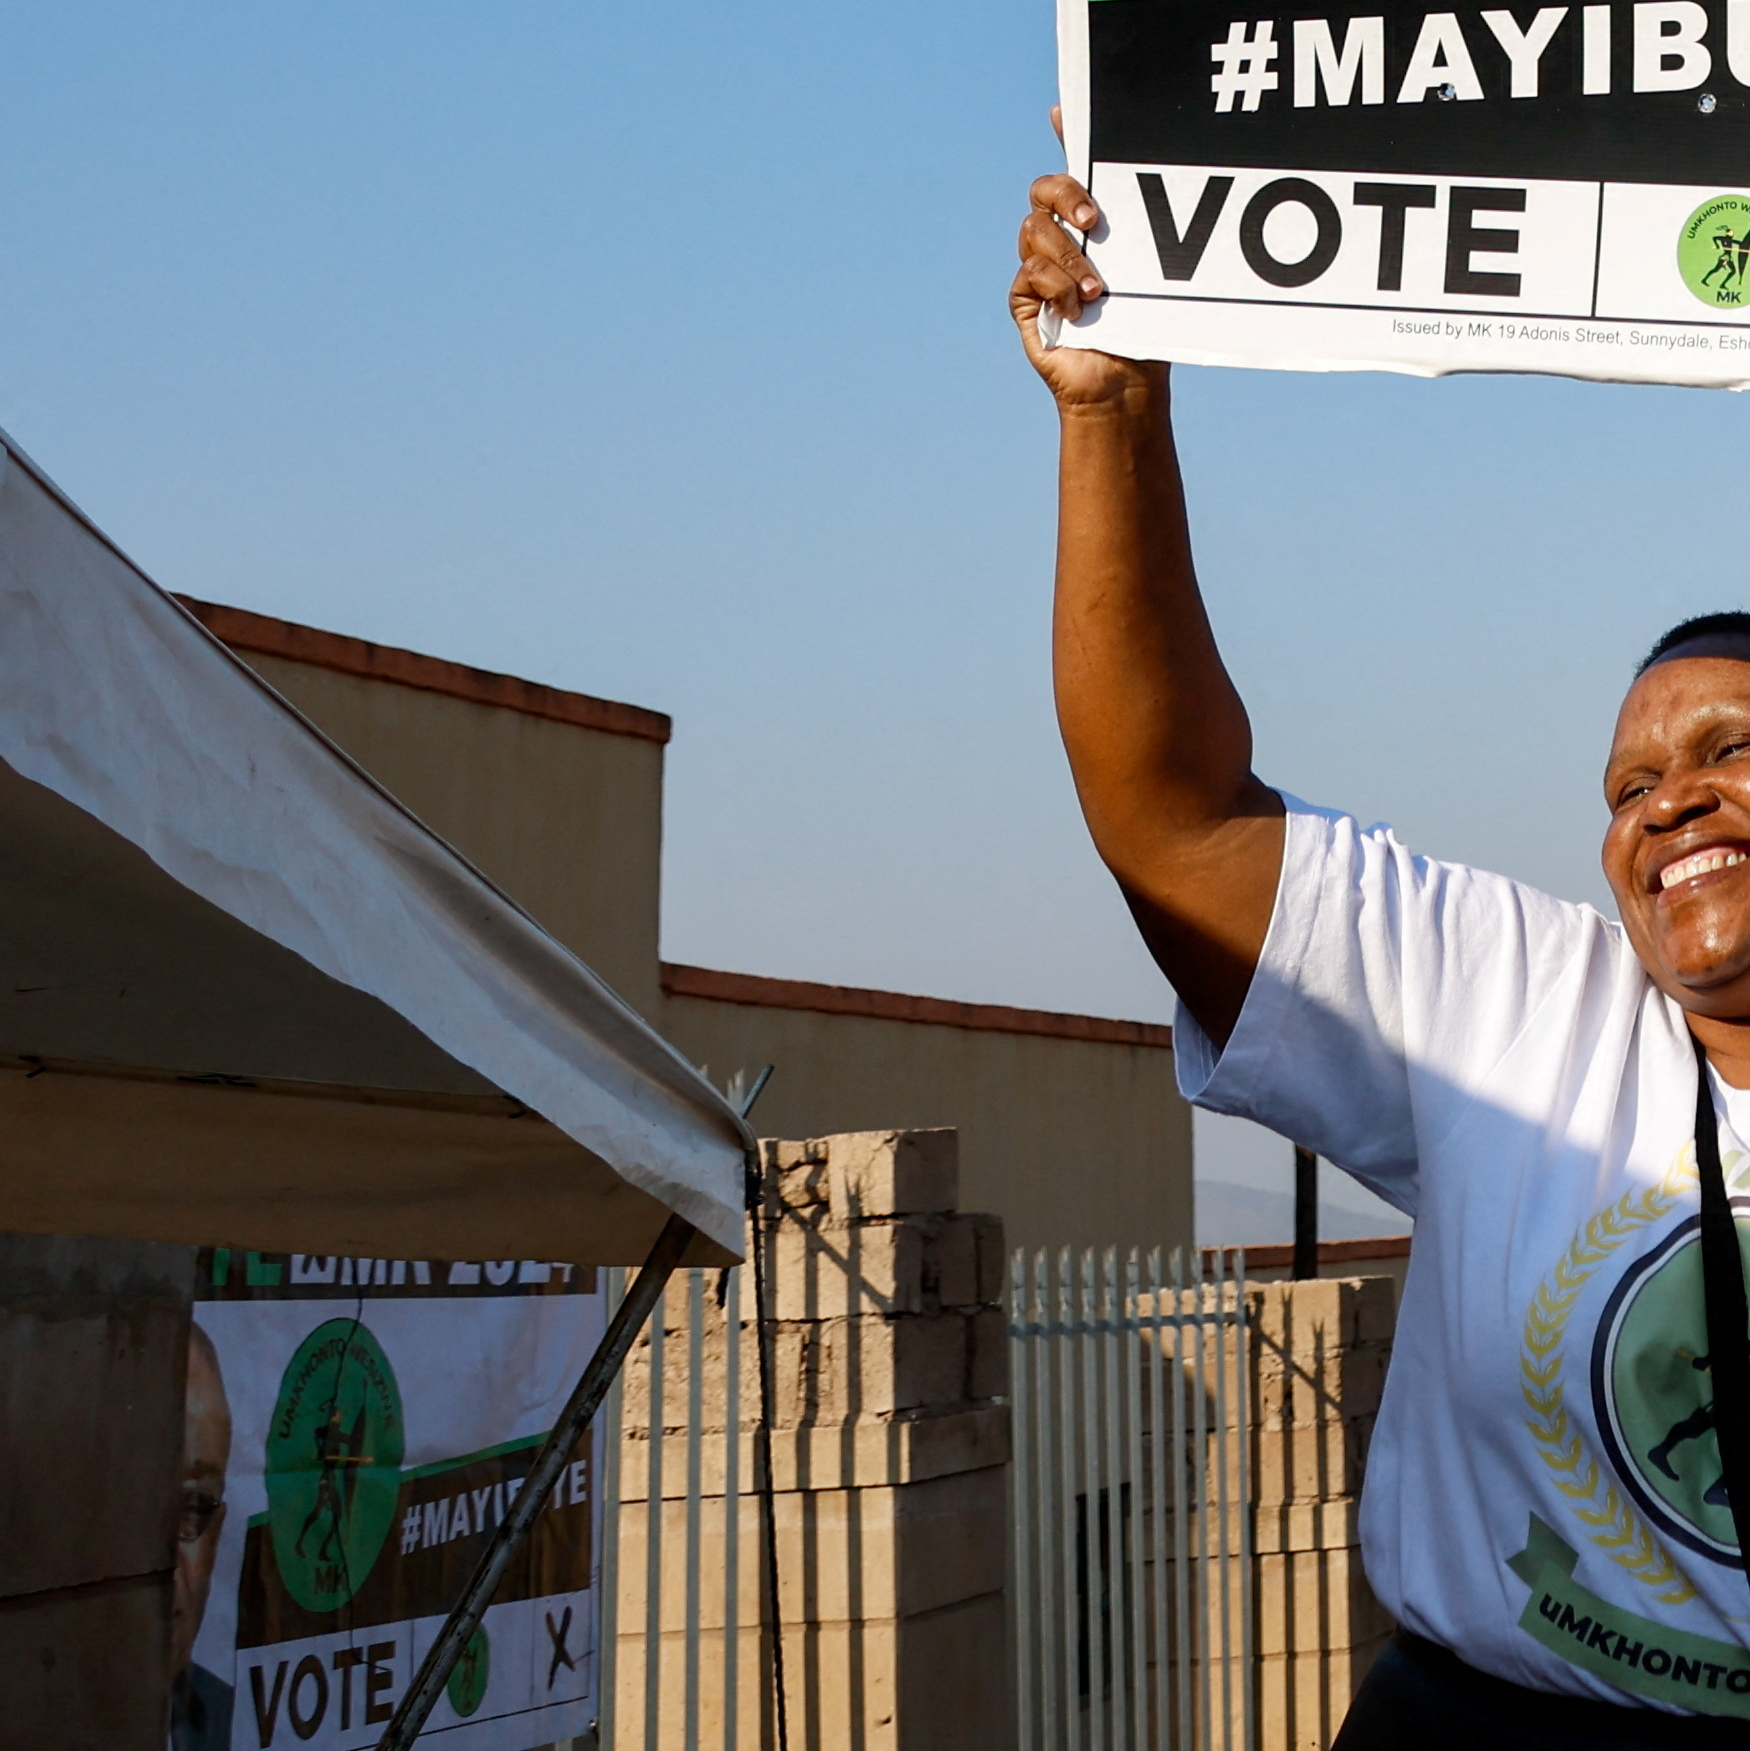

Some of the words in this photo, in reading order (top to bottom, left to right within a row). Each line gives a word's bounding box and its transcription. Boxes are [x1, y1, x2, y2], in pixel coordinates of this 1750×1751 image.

[1135, 171, 1528, 299] VOTE
[1687, 201, 1738, 239] UMKHONTO
[1716, 291, 1742, 303] MK
[1392, 319, 1441, 336] Issued
[1445, 321, 1463, 338] by
[1467, 323, 1492, 338] MK
[1498, 325, 1515, 339] 19
[1519, 325, 1571, 342] Adonis
[1575, 329, 1624, 346] Street,
[1629, 331, 1713, 350] Sunnydale,
[248, 1640, 398, 1749] VOTE
